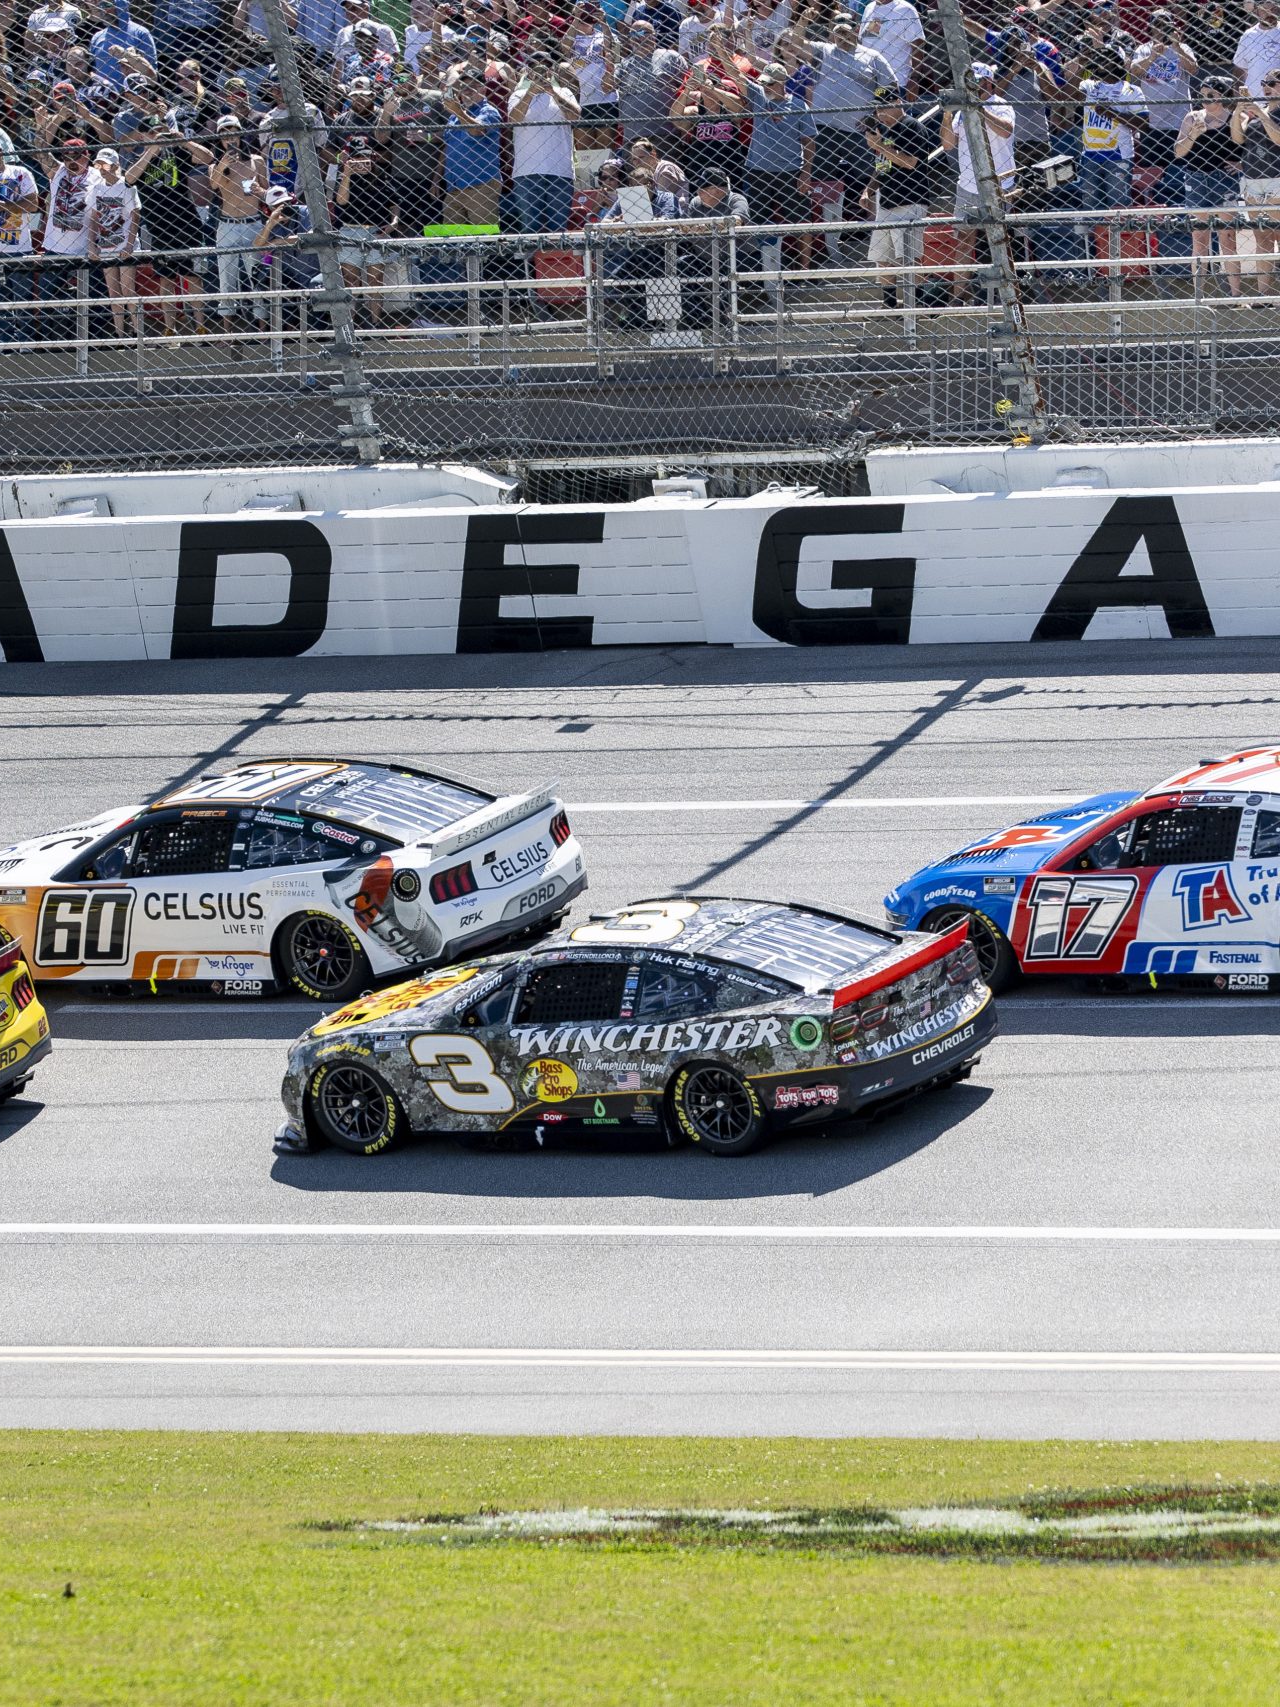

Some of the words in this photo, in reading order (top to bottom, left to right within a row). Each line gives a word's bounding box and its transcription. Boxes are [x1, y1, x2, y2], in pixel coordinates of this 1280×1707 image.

[321, 826, 360, 845] Castrol
[490, 841, 549, 883] CELSIUS
[266, 889, 316, 897] PERFORMANCE
[272, 880, 310, 888] ESSENTIAL
[923, 885, 977, 902] GOODYEAR
[520, 882, 556, 913] FORD
[1175, 866, 1248, 928] TA
[1248, 884, 1269, 906] of
[144, 892, 265, 920] CELSIUS
[35, 887, 137, 967] 60
[1024, 875, 1139, 961] 17
[222, 924, 248, 934] LIVE
[250, 924, 265, 935] FIT
[221, 956, 255, 976] Kroger
[650, 952, 675, 965] Huk
[676, 957, 720, 976] Fishing
[1209, 951, 1263, 963] FASTENAL
[224, 980, 262, 990] FORD
[291, 976, 321, 999] EAGLE
[735, 976, 756, 988] United
[972, 978, 986, 993] 3
[1229, 974, 1269, 984] FORD
[866, 993, 981, 1058] WINCHESTER
[509, 1016, 783, 1057] WINCHESTER
[912, 1023, 975, 1065] CHEVROLET
[410, 1034, 515, 1115] 3
[539, 1061, 562, 1074] Bass
[577, 1058, 592, 1071] The
[595, 1058, 639, 1072] American
[641, 1060, 669, 1078] Legend
[542, 1073, 559, 1084] Pro
[544, 1084, 573, 1098] Shops
[742, 1080, 761, 1118] EAGLE
[778, 1092, 798, 1103] TOYS
[802, 1090, 816, 1101] FOR
[819, 1087, 839, 1099] TOTS
